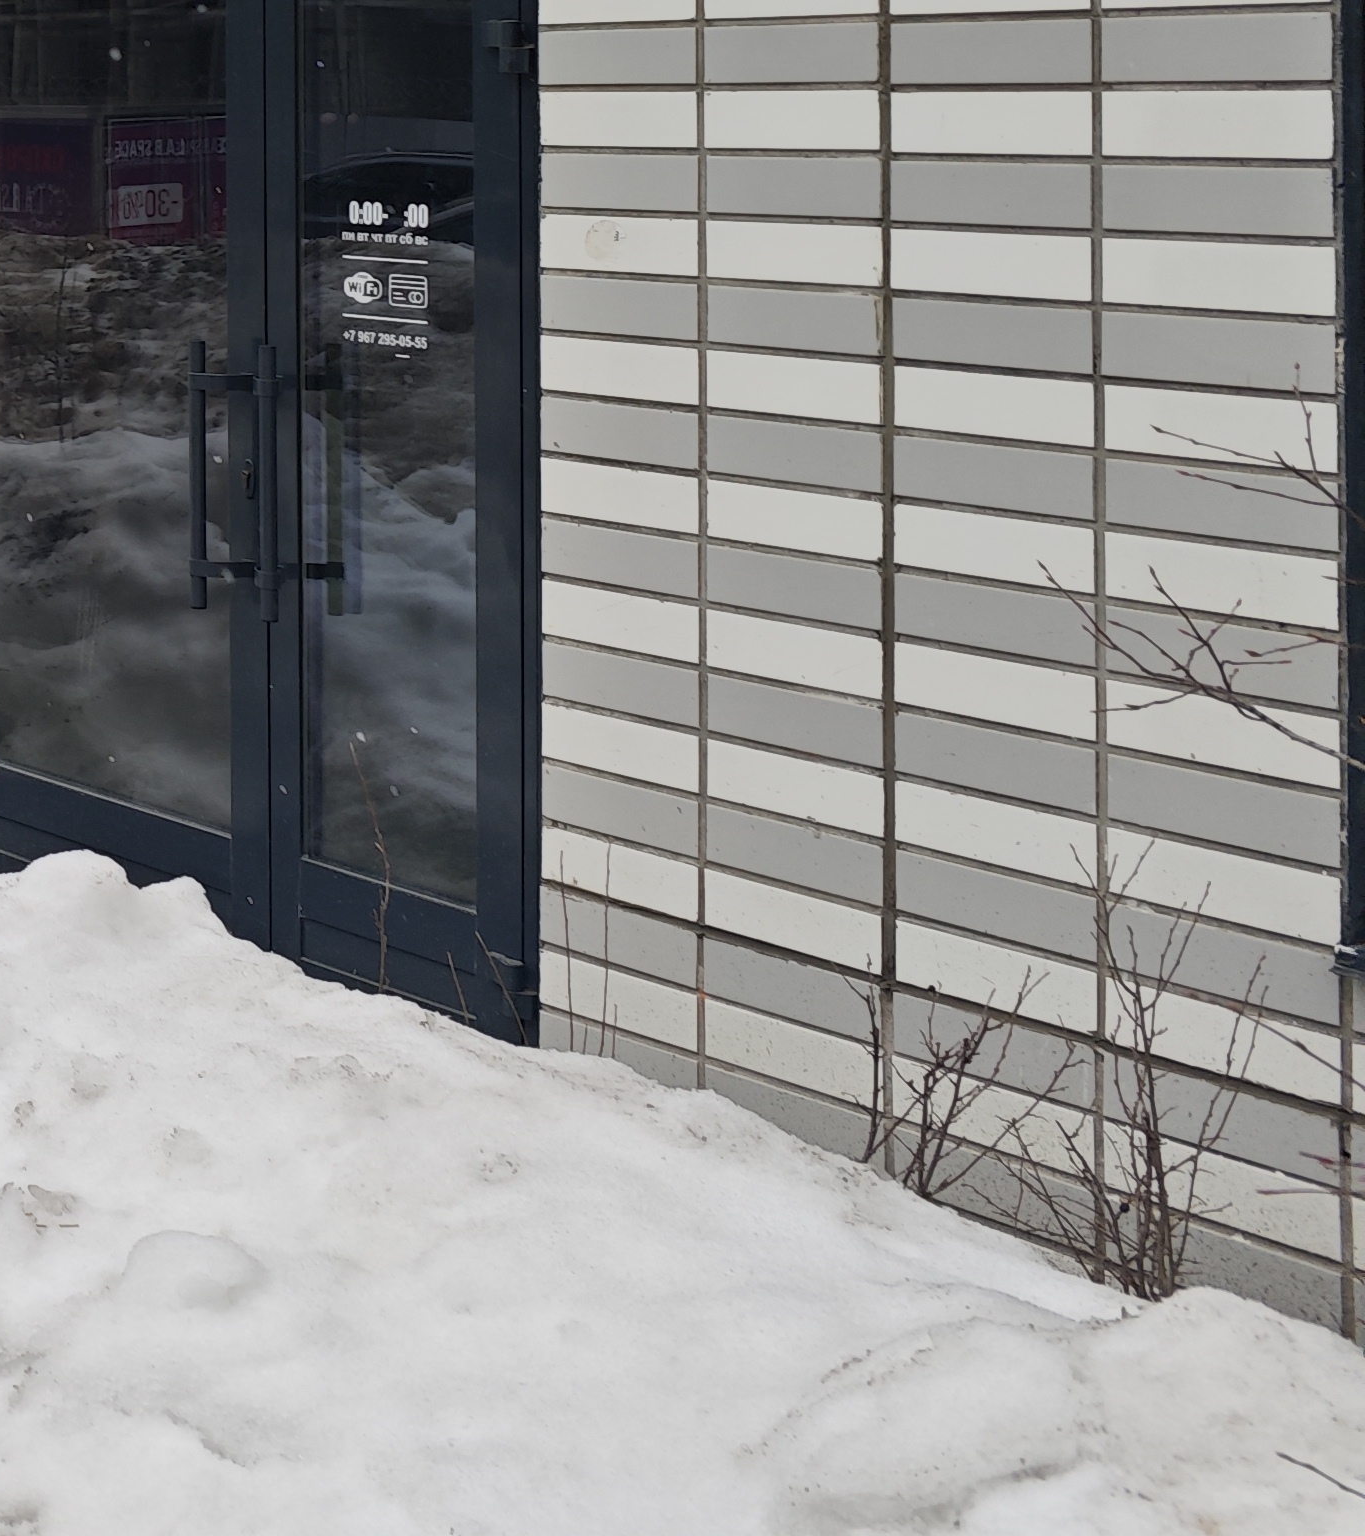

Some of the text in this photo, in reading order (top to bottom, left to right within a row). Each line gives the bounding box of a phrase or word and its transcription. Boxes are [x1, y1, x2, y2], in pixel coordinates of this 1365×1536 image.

[342, 329, 428, 350] +7 967 295-05-55
